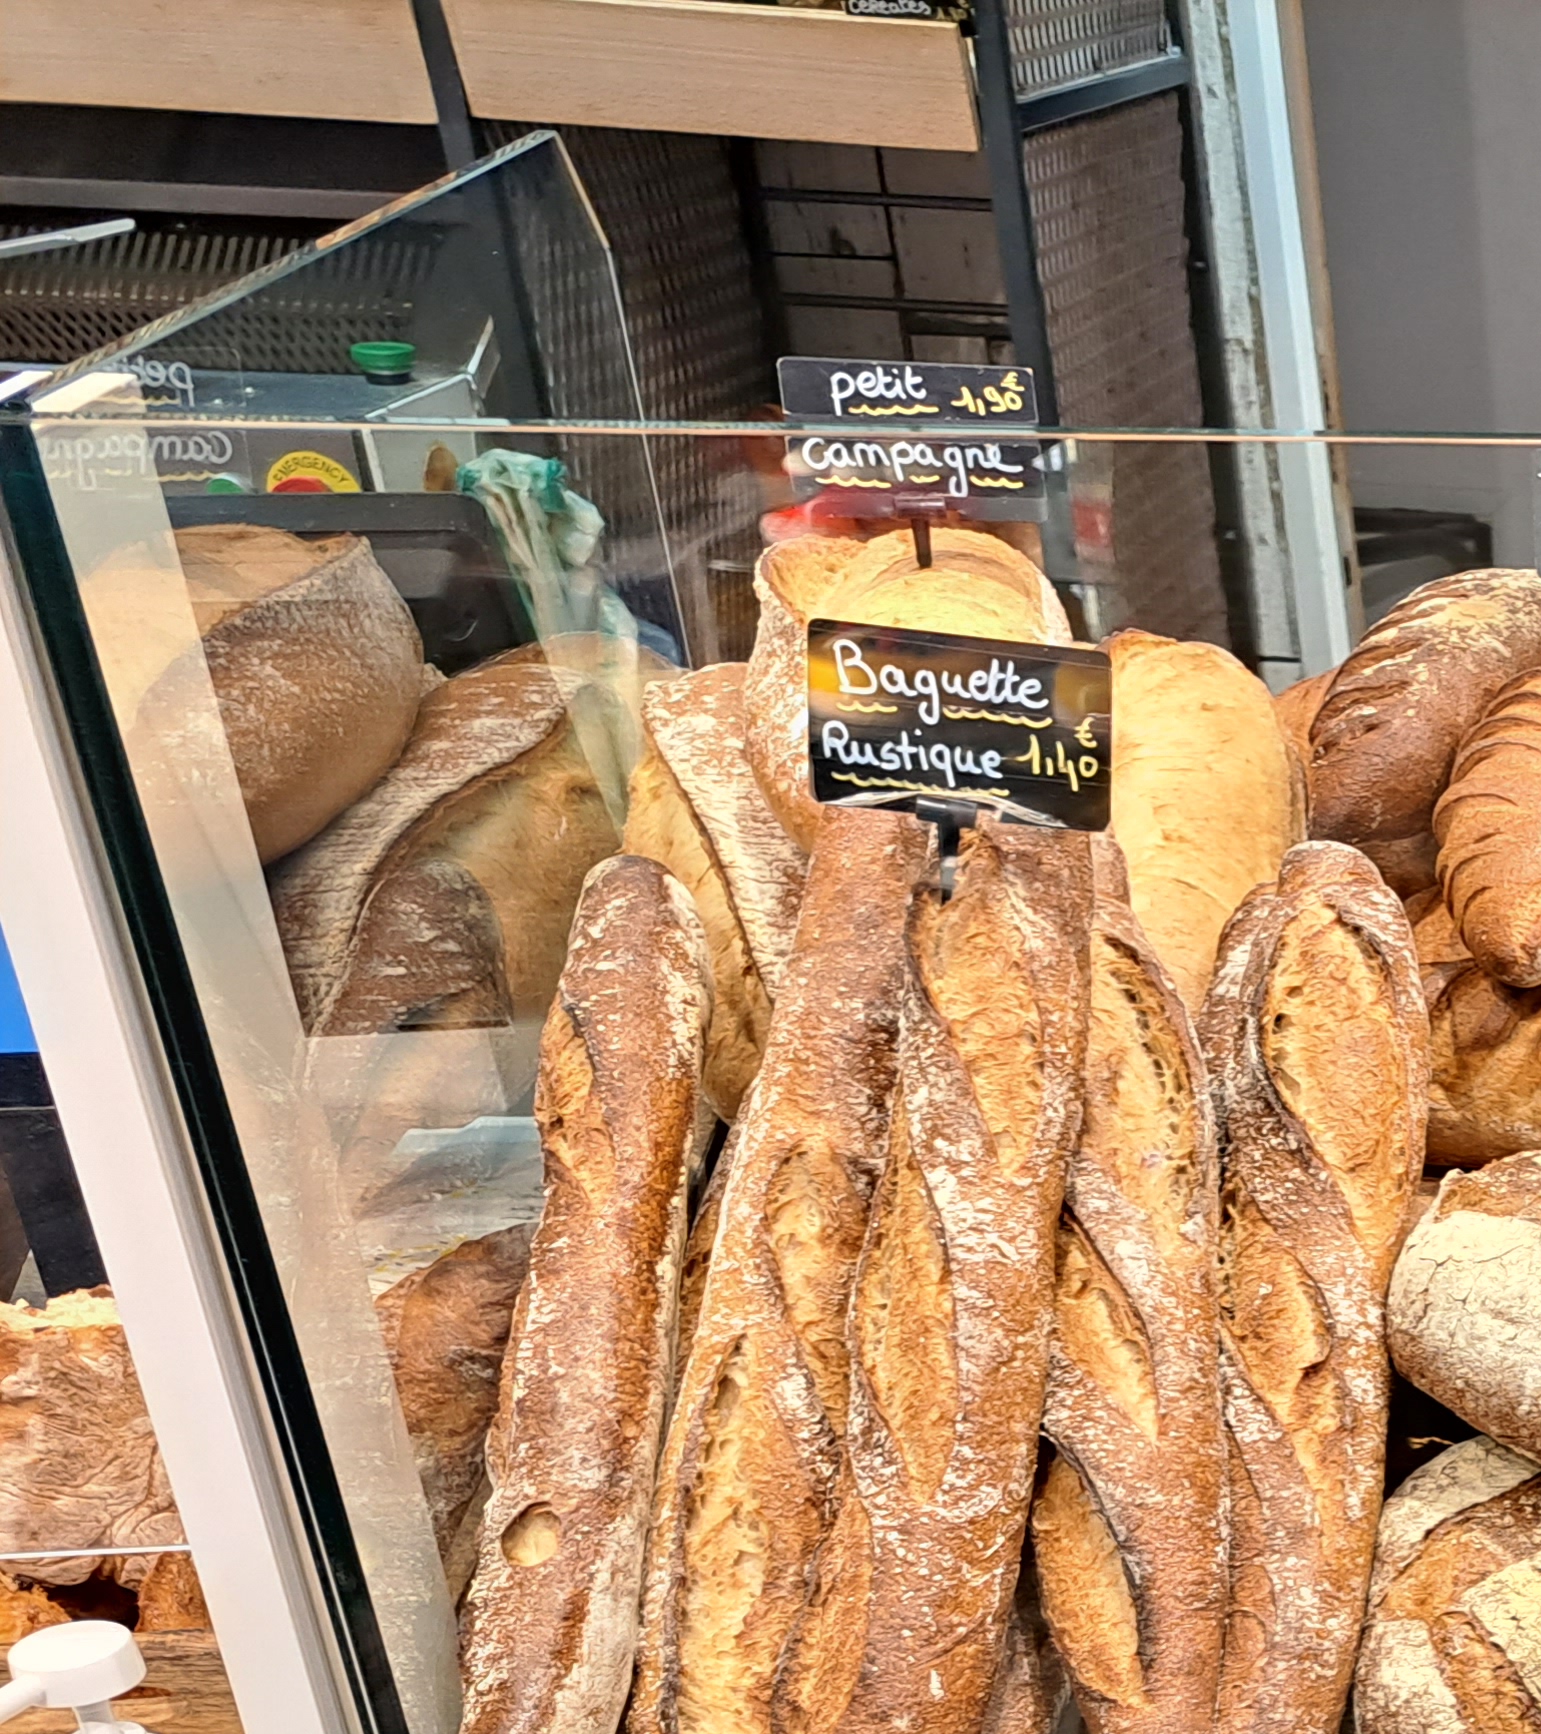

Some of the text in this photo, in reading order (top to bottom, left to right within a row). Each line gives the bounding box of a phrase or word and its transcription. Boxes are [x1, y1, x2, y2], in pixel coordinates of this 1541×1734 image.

[802, 437, 1024, 498] Campagne
[832, 638, 1050, 726] Baguette
[821, 720, 1004, 788] Rustique
